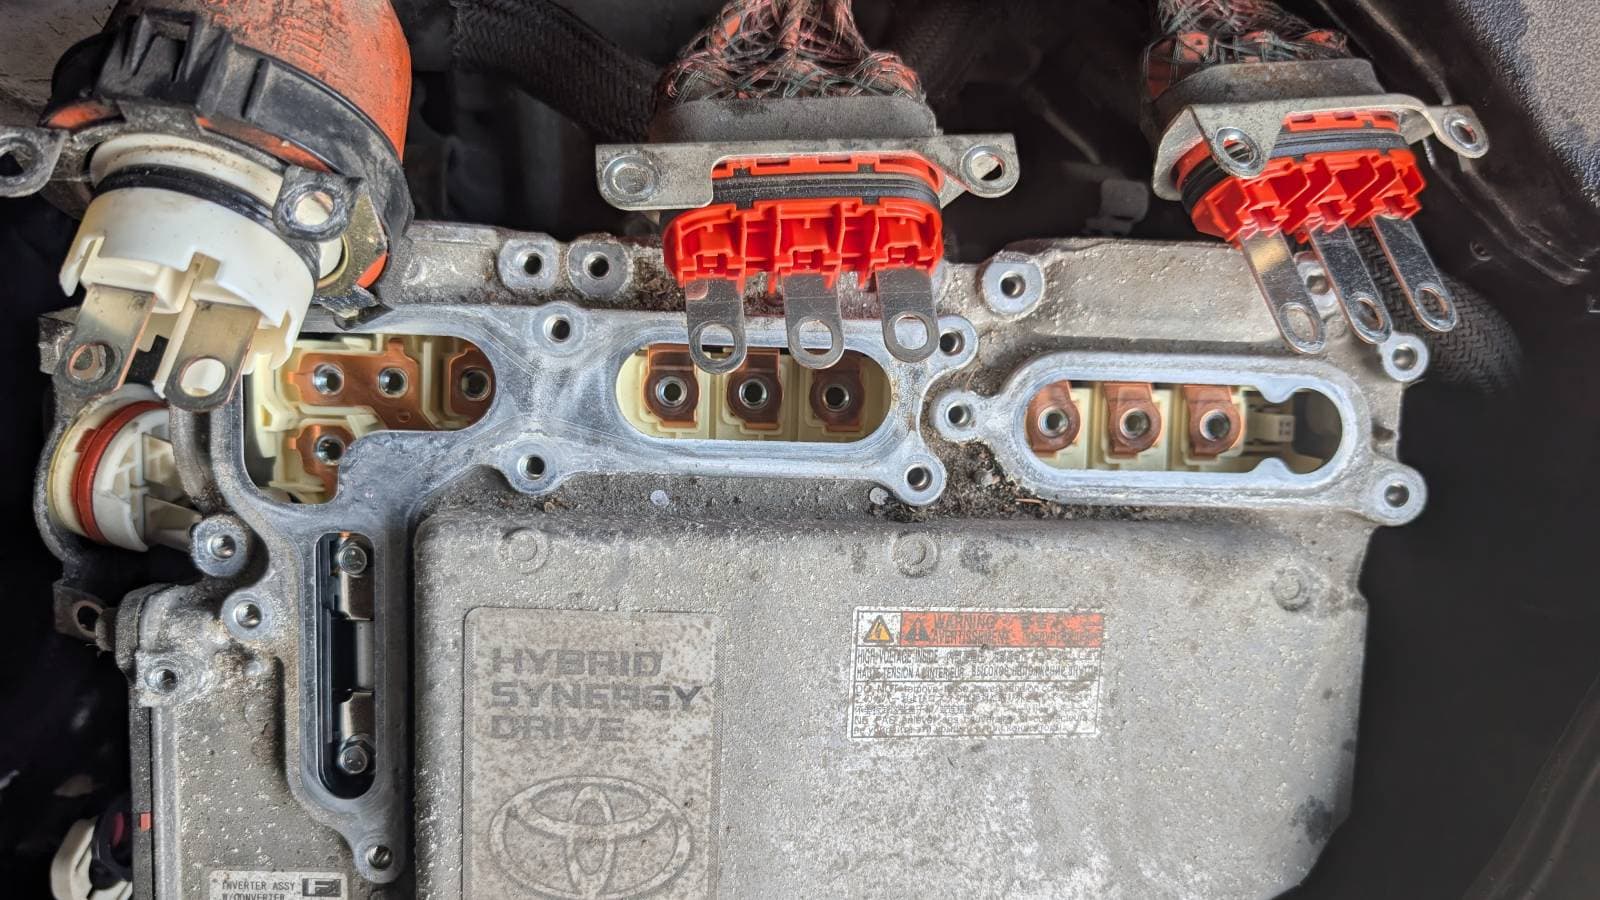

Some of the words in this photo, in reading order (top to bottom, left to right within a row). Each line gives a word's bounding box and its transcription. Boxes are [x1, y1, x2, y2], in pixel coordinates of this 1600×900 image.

[491, 647, 664, 677] HYBRID
[491, 681, 703, 711] SYNERGY
[490, 715, 626, 741] DRIVE
[222, 880, 267, 890] INVERTER
[272, 881, 296, 891] ASSY
